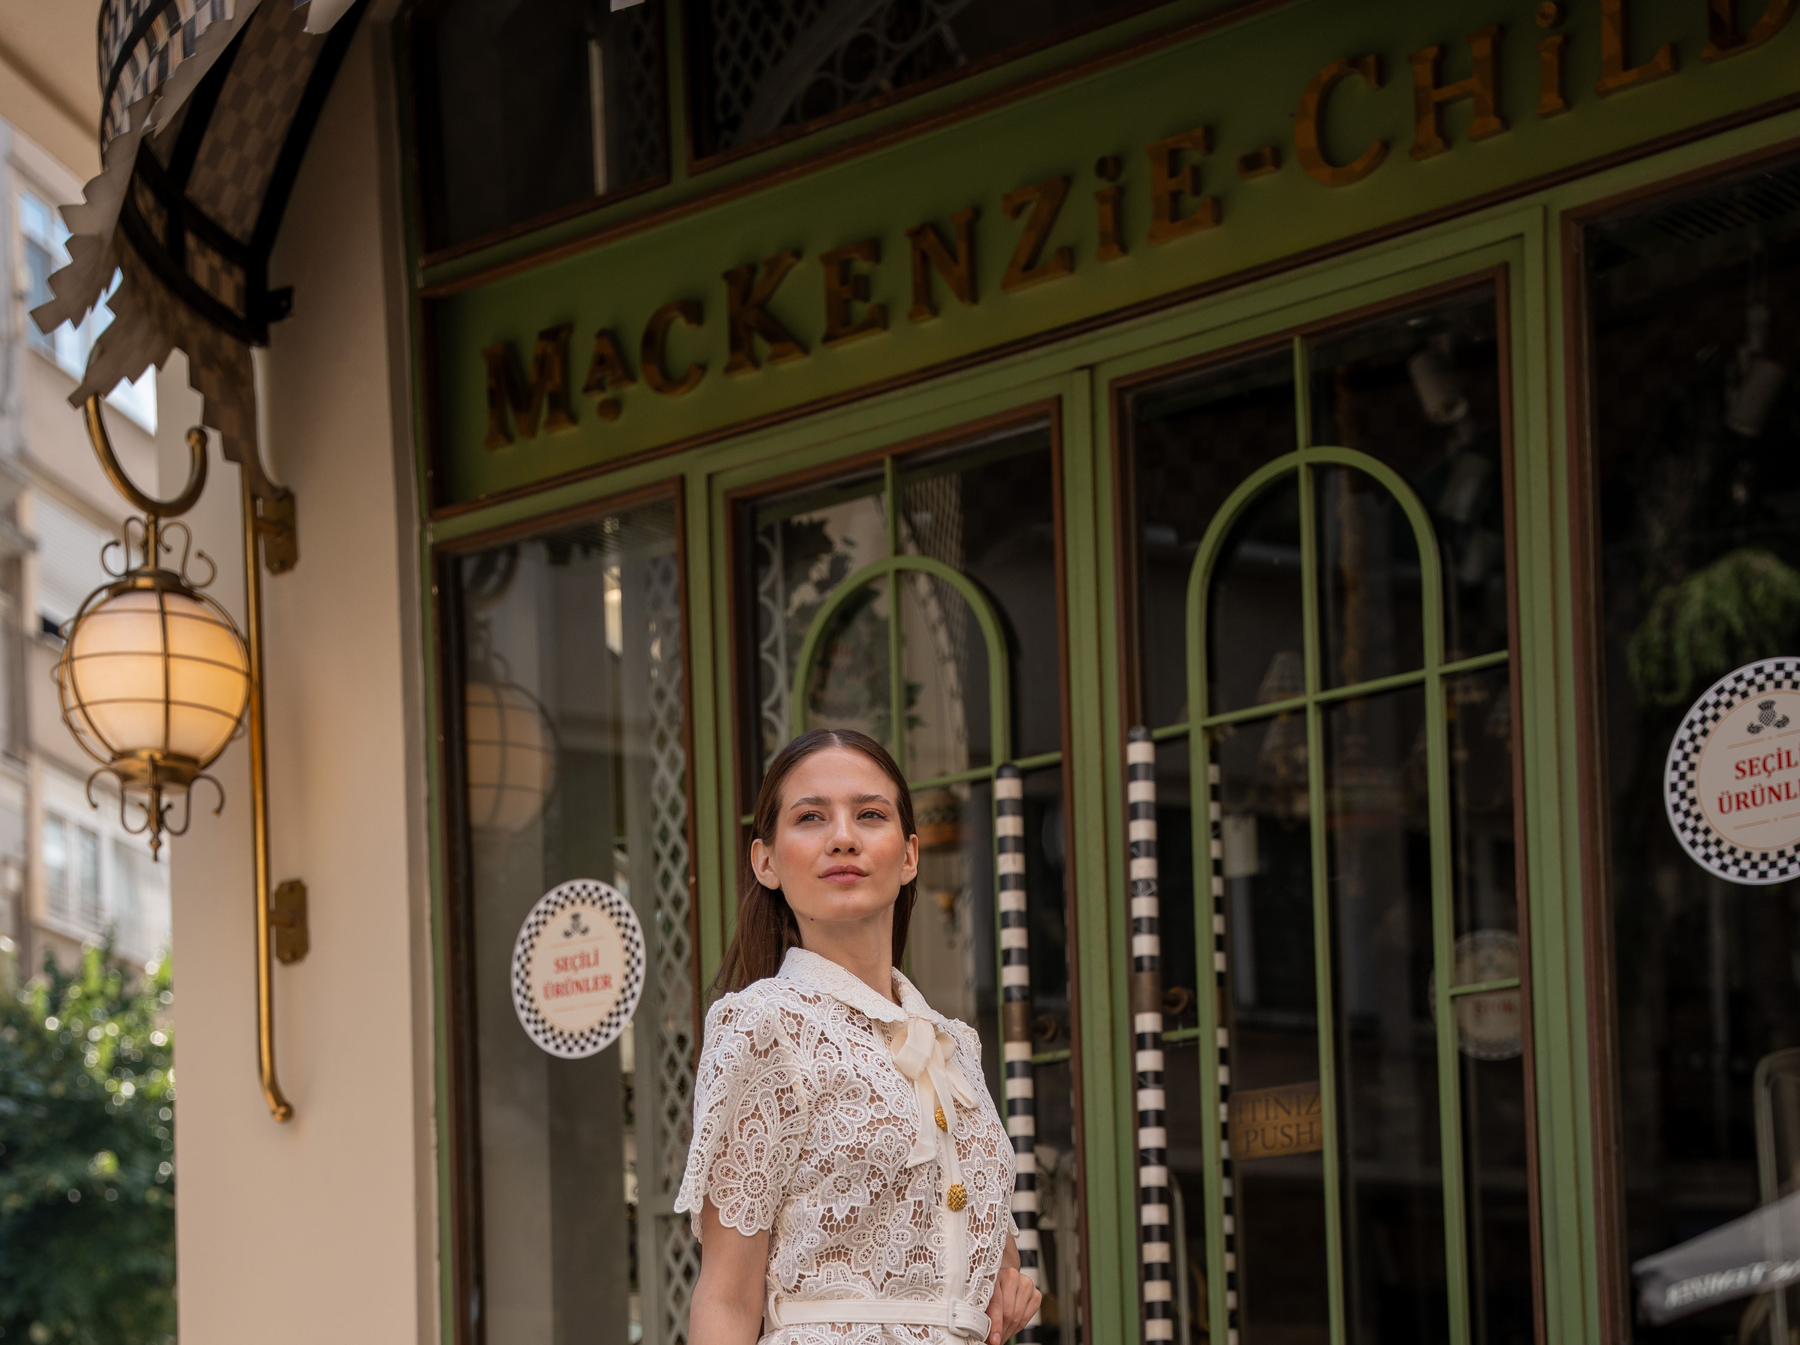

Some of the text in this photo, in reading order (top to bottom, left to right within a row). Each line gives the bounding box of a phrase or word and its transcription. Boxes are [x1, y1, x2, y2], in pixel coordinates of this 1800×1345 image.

[1734, 742, 1800, 780] SEÇİL
[1717, 778, 1800, 815] ÜRÜNL
[1244, 1121, 1315, 1153] PUSH
